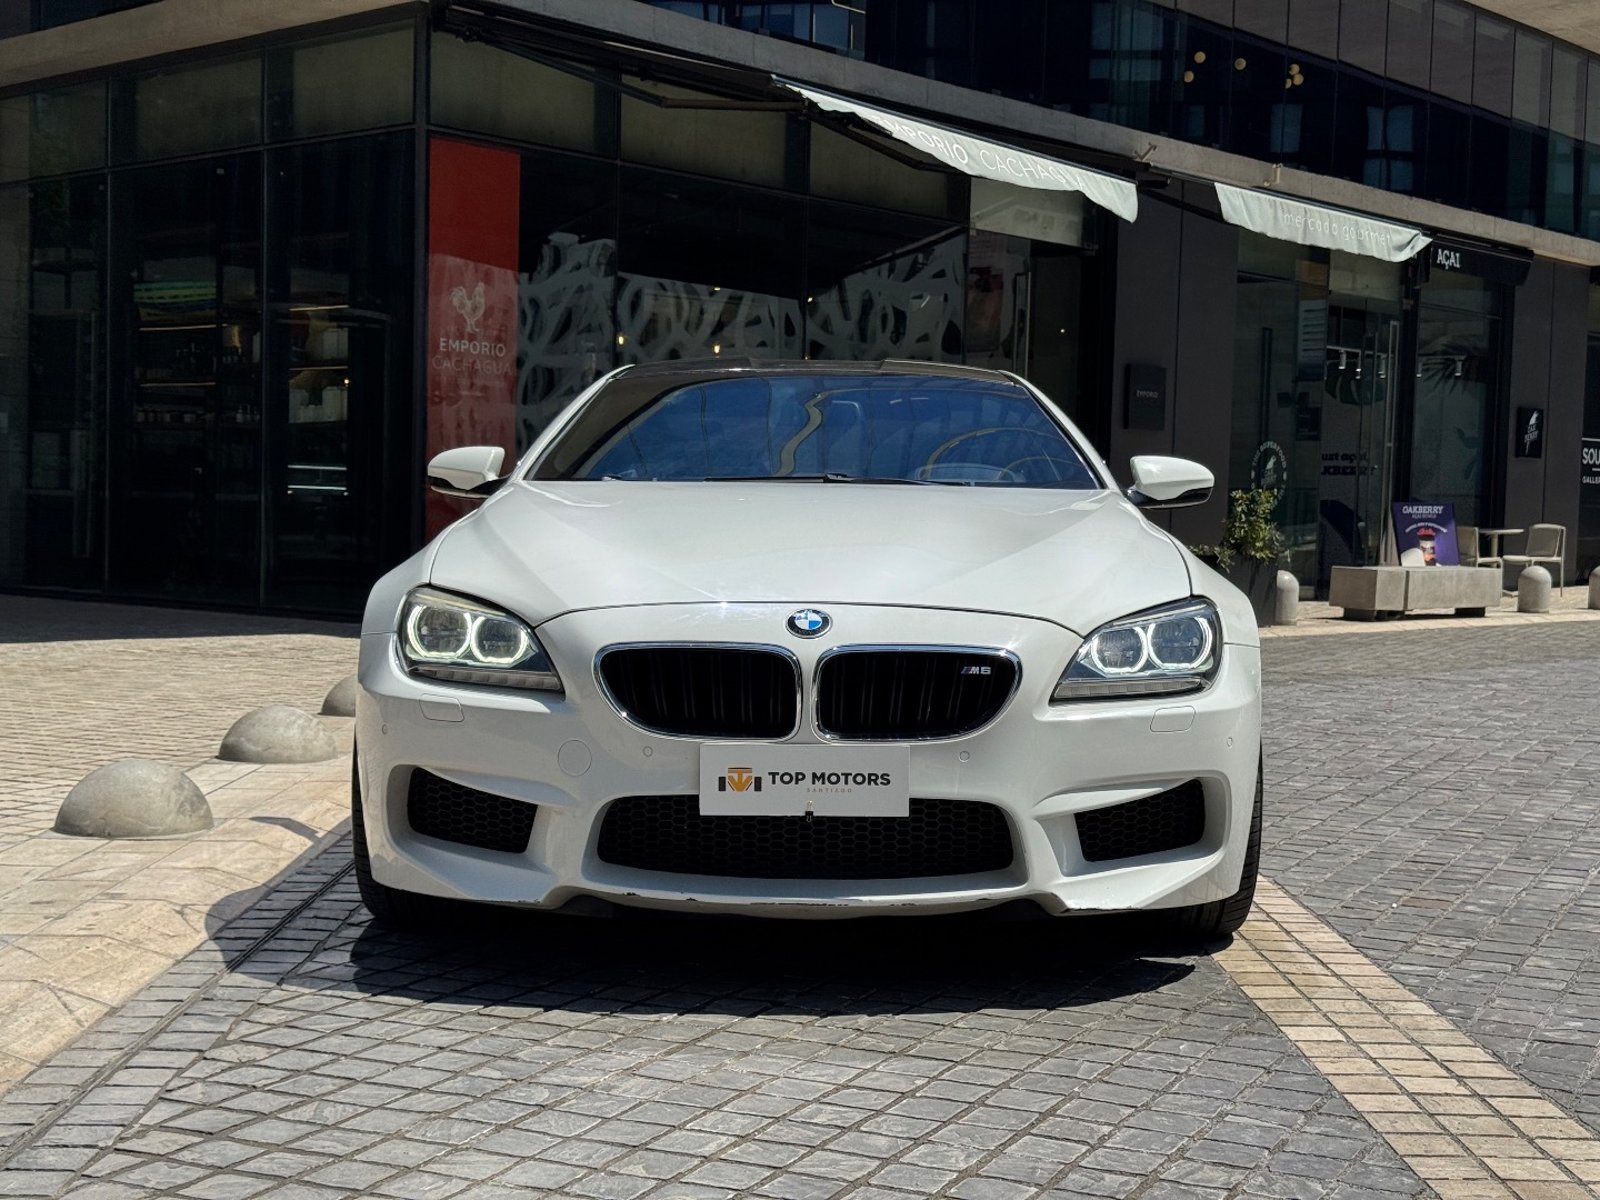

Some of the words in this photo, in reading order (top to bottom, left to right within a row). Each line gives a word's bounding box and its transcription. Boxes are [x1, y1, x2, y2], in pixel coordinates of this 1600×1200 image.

[439, 337, 507, 358] EMPORIO
[1402, 505, 1444, 514] OAKBERRY
[768, 772, 806, 785] TOP
[811, 772, 891, 786] MOTORS
